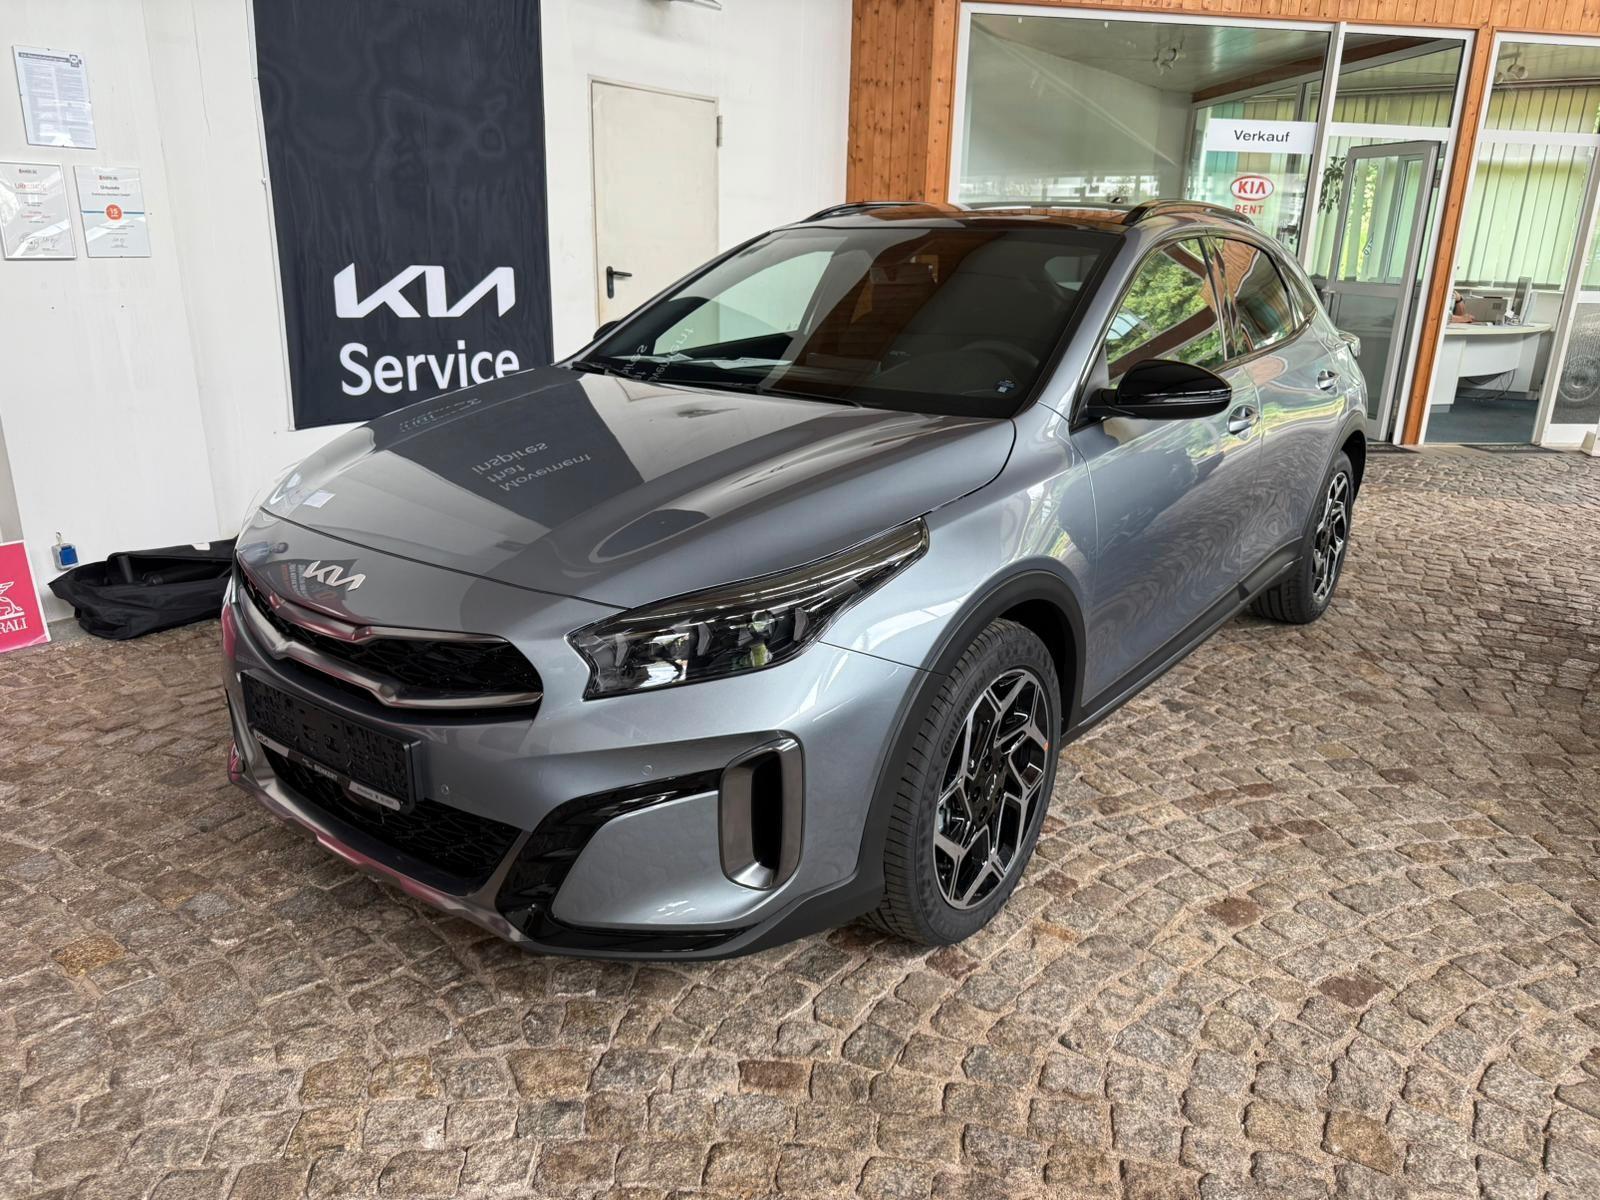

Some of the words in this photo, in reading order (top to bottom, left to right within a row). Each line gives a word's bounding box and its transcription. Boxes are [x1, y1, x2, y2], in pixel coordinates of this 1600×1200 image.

[1233, 129, 1290, 143] Verkauf
[1237, 181, 1266, 195] KIA
[1235, 204, 1264, 215] RENT
[333, 262, 516, 319] KIA
[339, 339, 520, 396] Service
[302, 560, 367, 592] KIA
